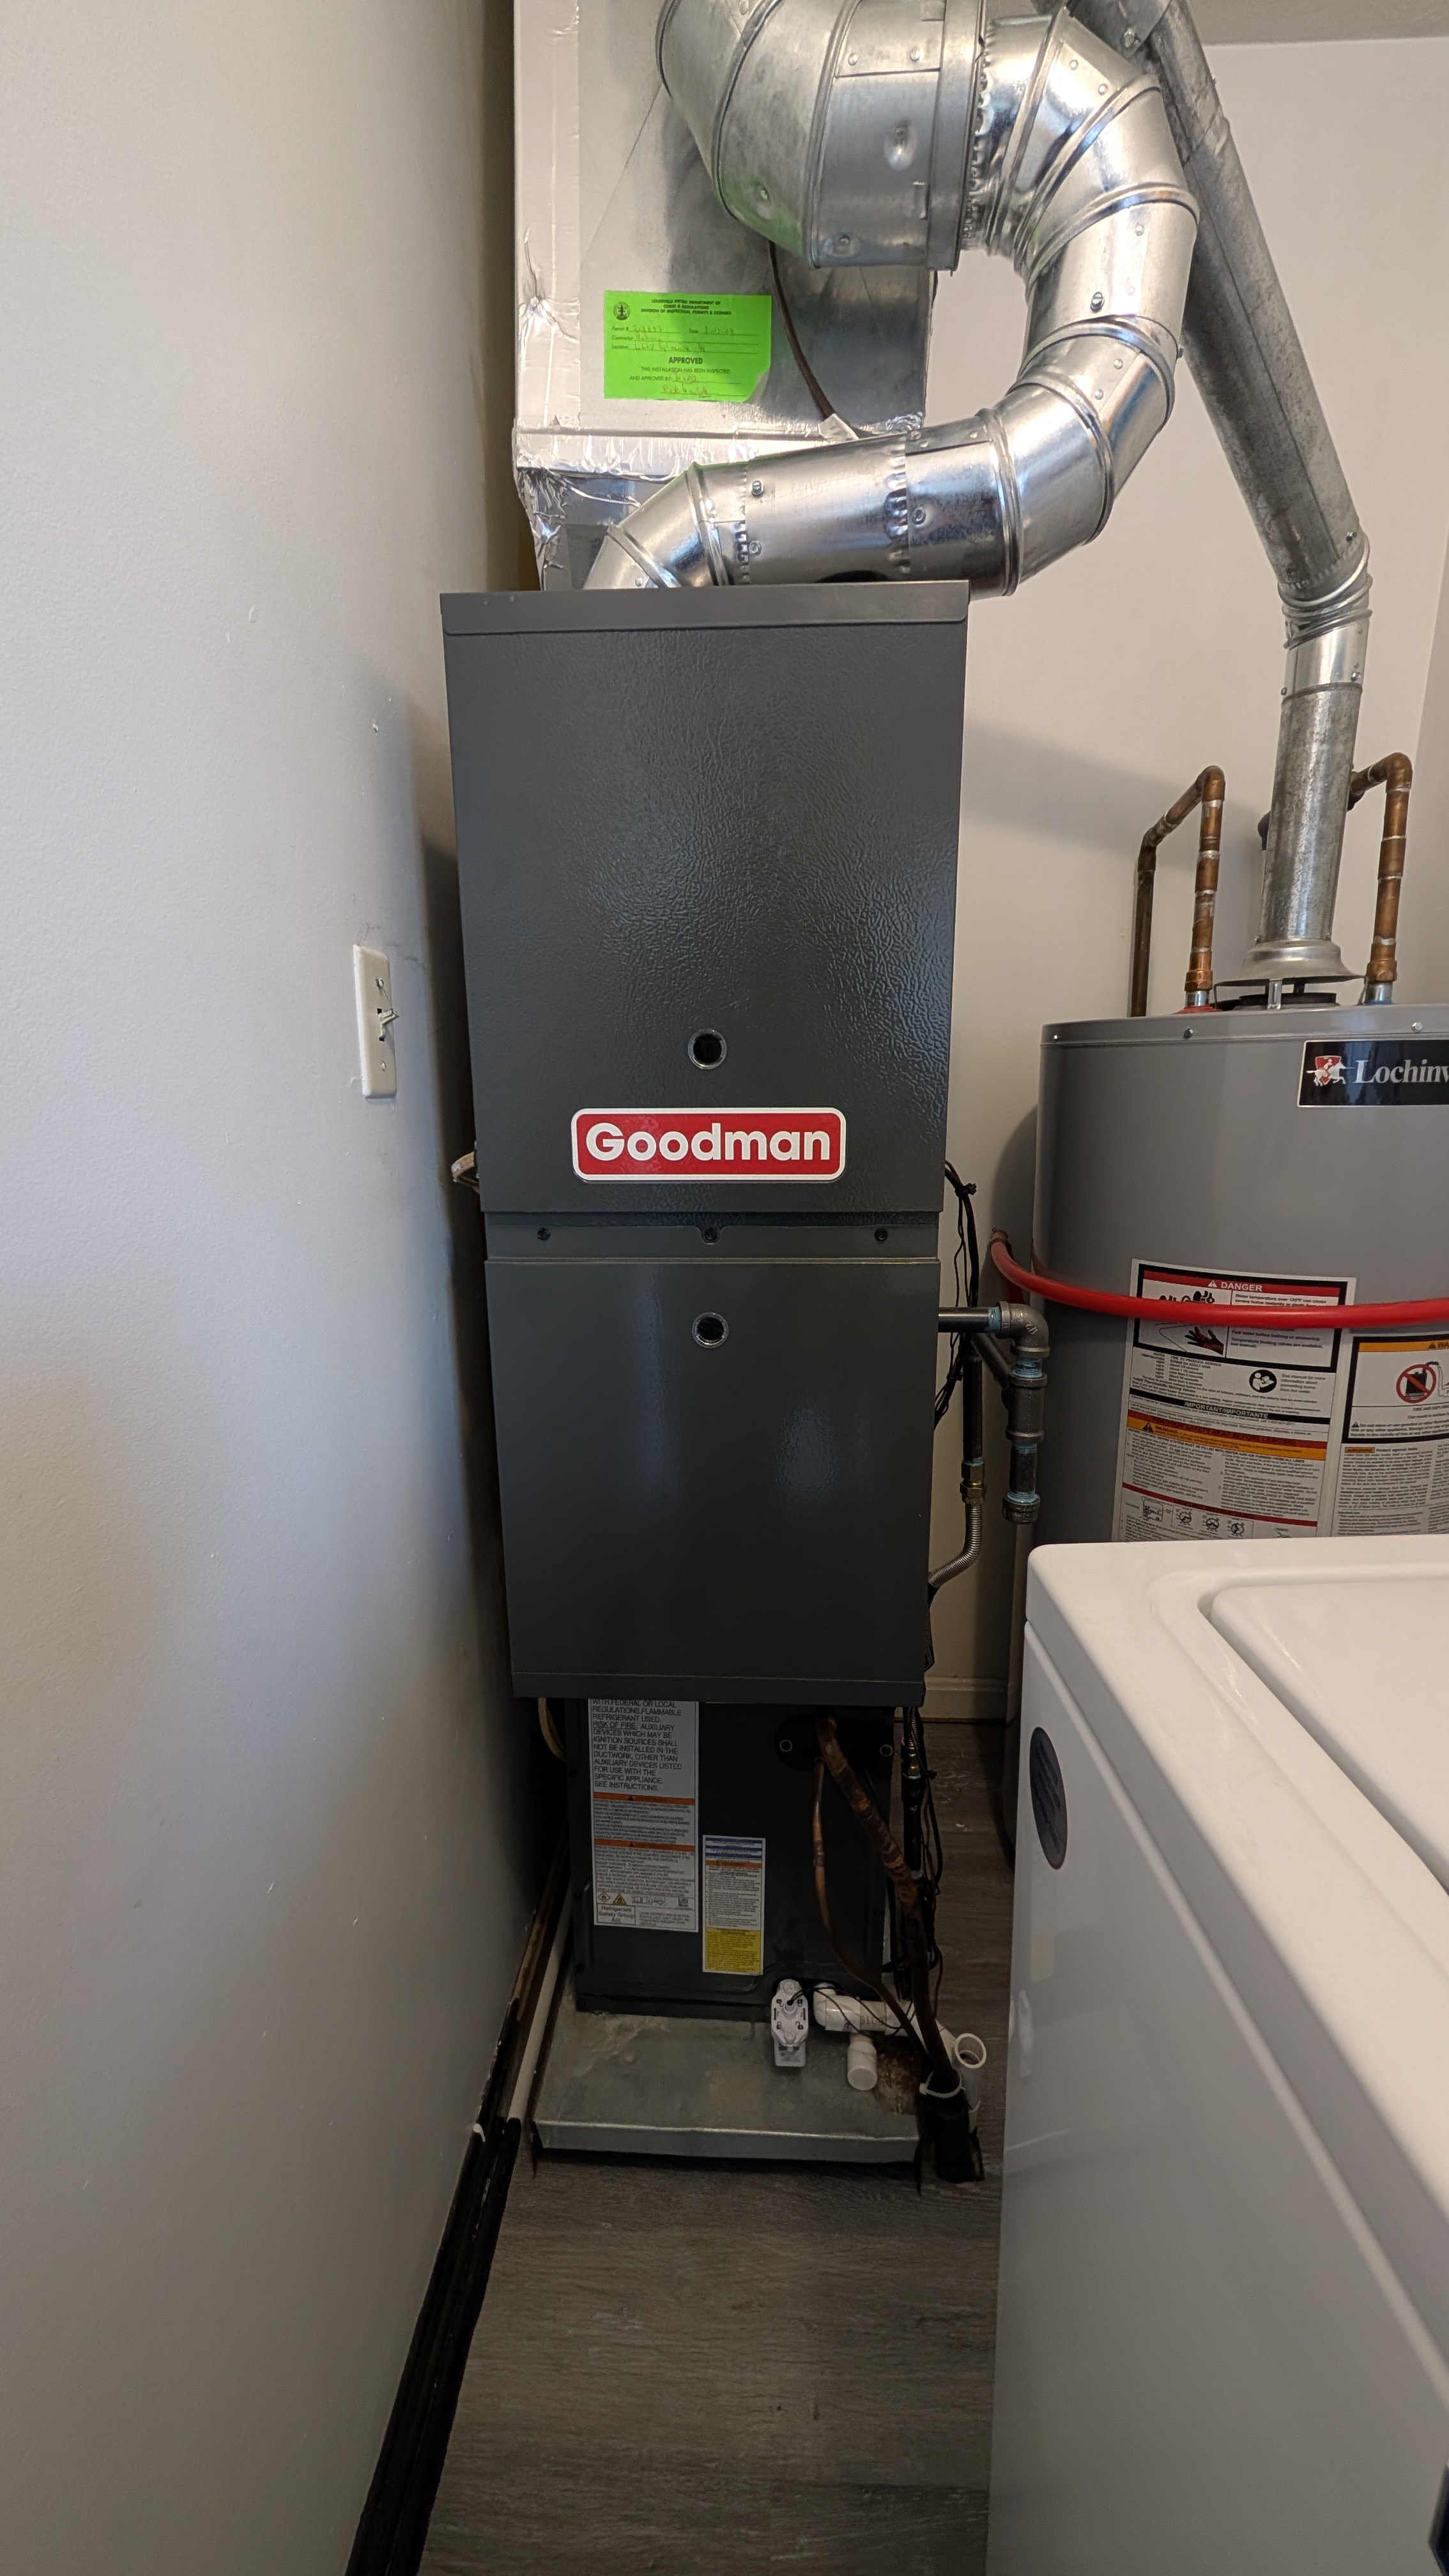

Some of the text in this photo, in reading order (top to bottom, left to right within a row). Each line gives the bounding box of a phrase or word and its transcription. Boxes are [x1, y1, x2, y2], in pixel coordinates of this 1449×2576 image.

[586, 1123, 830, 1162] Goodman
[1221, 1282, 1262, 1292] DANGER
[593, 1713, 640, 1722] REFRIGERANT
[594, 1758, 628, 1767] AUXILIARY
